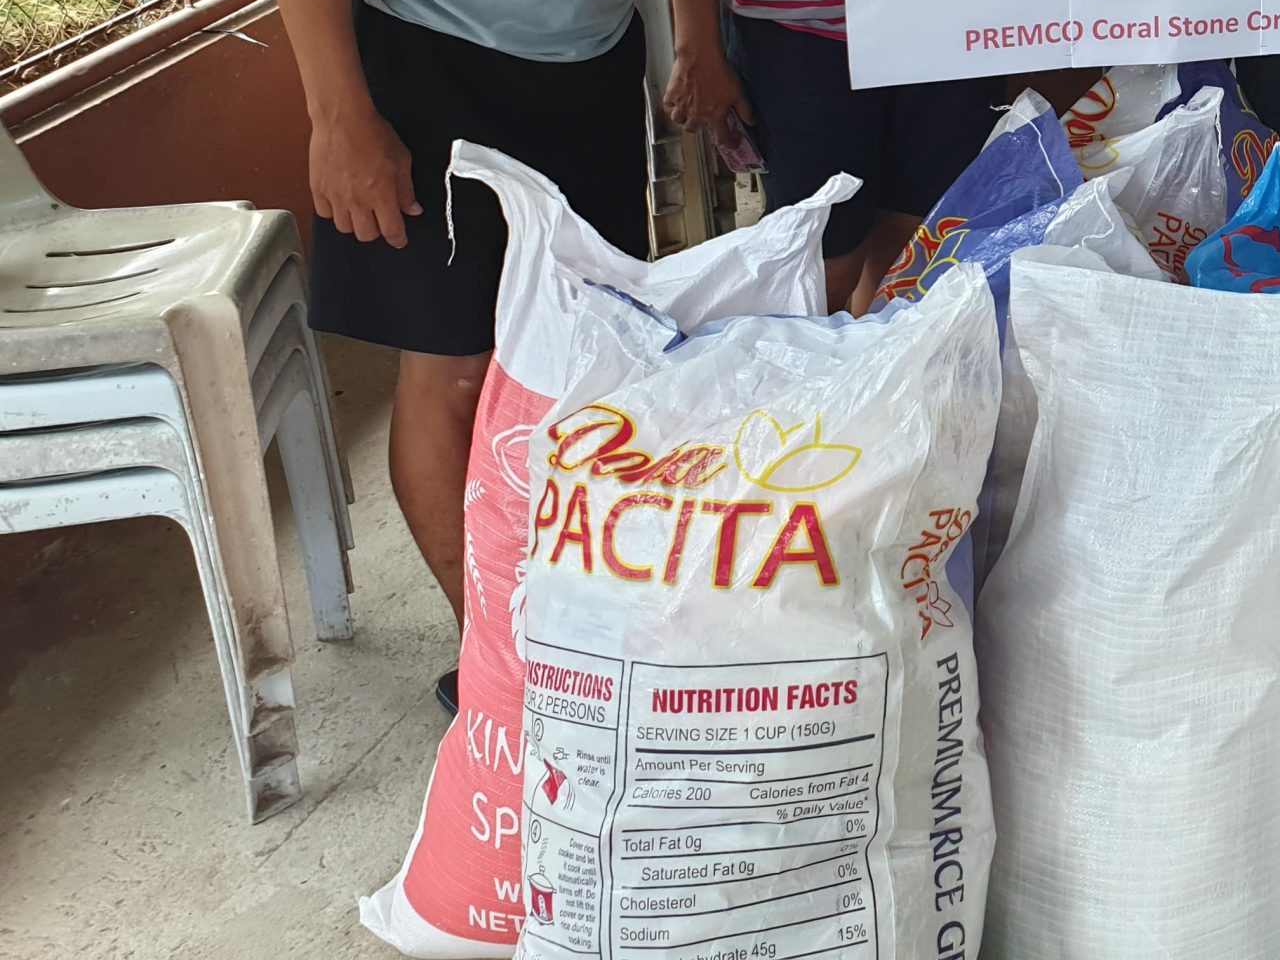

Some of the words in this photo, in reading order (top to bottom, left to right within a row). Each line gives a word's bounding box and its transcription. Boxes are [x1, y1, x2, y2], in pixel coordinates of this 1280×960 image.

[964, 19, 1084, 53] PREMCO
[1092, 15, 1160, 41] Coral
[1168, 13, 1240, 39] Stone
[530, 477, 841, 589] PACITA
[526, 659, 615, 702] NSTRUCTIONS
[651, 685, 779, 714] NUTRITION
[786, 679, 859, 711] FACTS
[537, 693, 544, 711] 2
[545, 694, 606, 724] PERSONS
[636, 726, 701, 742] SERVING
[704, 727, 738, 741] SIZE
[743, 727, 750, 741] 1
[754, 725, 787, 740] CUP
[790, 721, 837, 740] (150G)
[935, 650, 964, 828] PREMIUM
[576, 749, 596, 761] Rinse
[596, 753, 611, 765] until
[576, 763, 599, 775] water
[634, 757, 686, 772] Amount
[689, 758, 712, 772] Per
[715, 760, 766, 777] Serving
[577, 776, 600, 788] clear.
[749, 785, 805, 801] Calories
[808, 782, 836, 795] from
[839, 775, 861, 790] Fat
[861, 772, 870, 785] 4
[632, 786, 683, 800] Calories
[685, 787, 712, 801] 200
[776, 808, 789, 820] %
[792, 803, 825, 820] Daily
[845, 818, 867, 834] 0%
[569, 837, 584, 851] Cover
[584, 843, 595, 855] rice
[622, 837, 655, 853] Total
[658, 836, 682, 851] Fat
[684, 835, 703, 853] 0g
[575, 854, 586, 864] and
[587, 856, 596, 866] let
[928, 824, 966, 912] RICE
[582, 866, 597, 877] until
[641, 862, 709, 882] Saturated
[712, 862, 736, 878] Fat
[737, 861, 756, 878] 0g
[836, 861, 859, 879] 0%
[558, 873, 598, 889] automatically
[586, 889, 596, 900] Do
[619, 894, 697, 912] Cholesterol
[841, 892, 864, 909] 0%
[565, 899, 576, 908] not
[585, 901, 596, 912] the
[559, 909, 577, 920] cover
[577, 912, 586, 921] or
[585, 913, 597, 924] stir
[571, 922, 594, 937] during
[619, 927, 671, 942] Sodium
[836, 924, 868, 943] 15%
[751, 942, 777, 958] 45g
